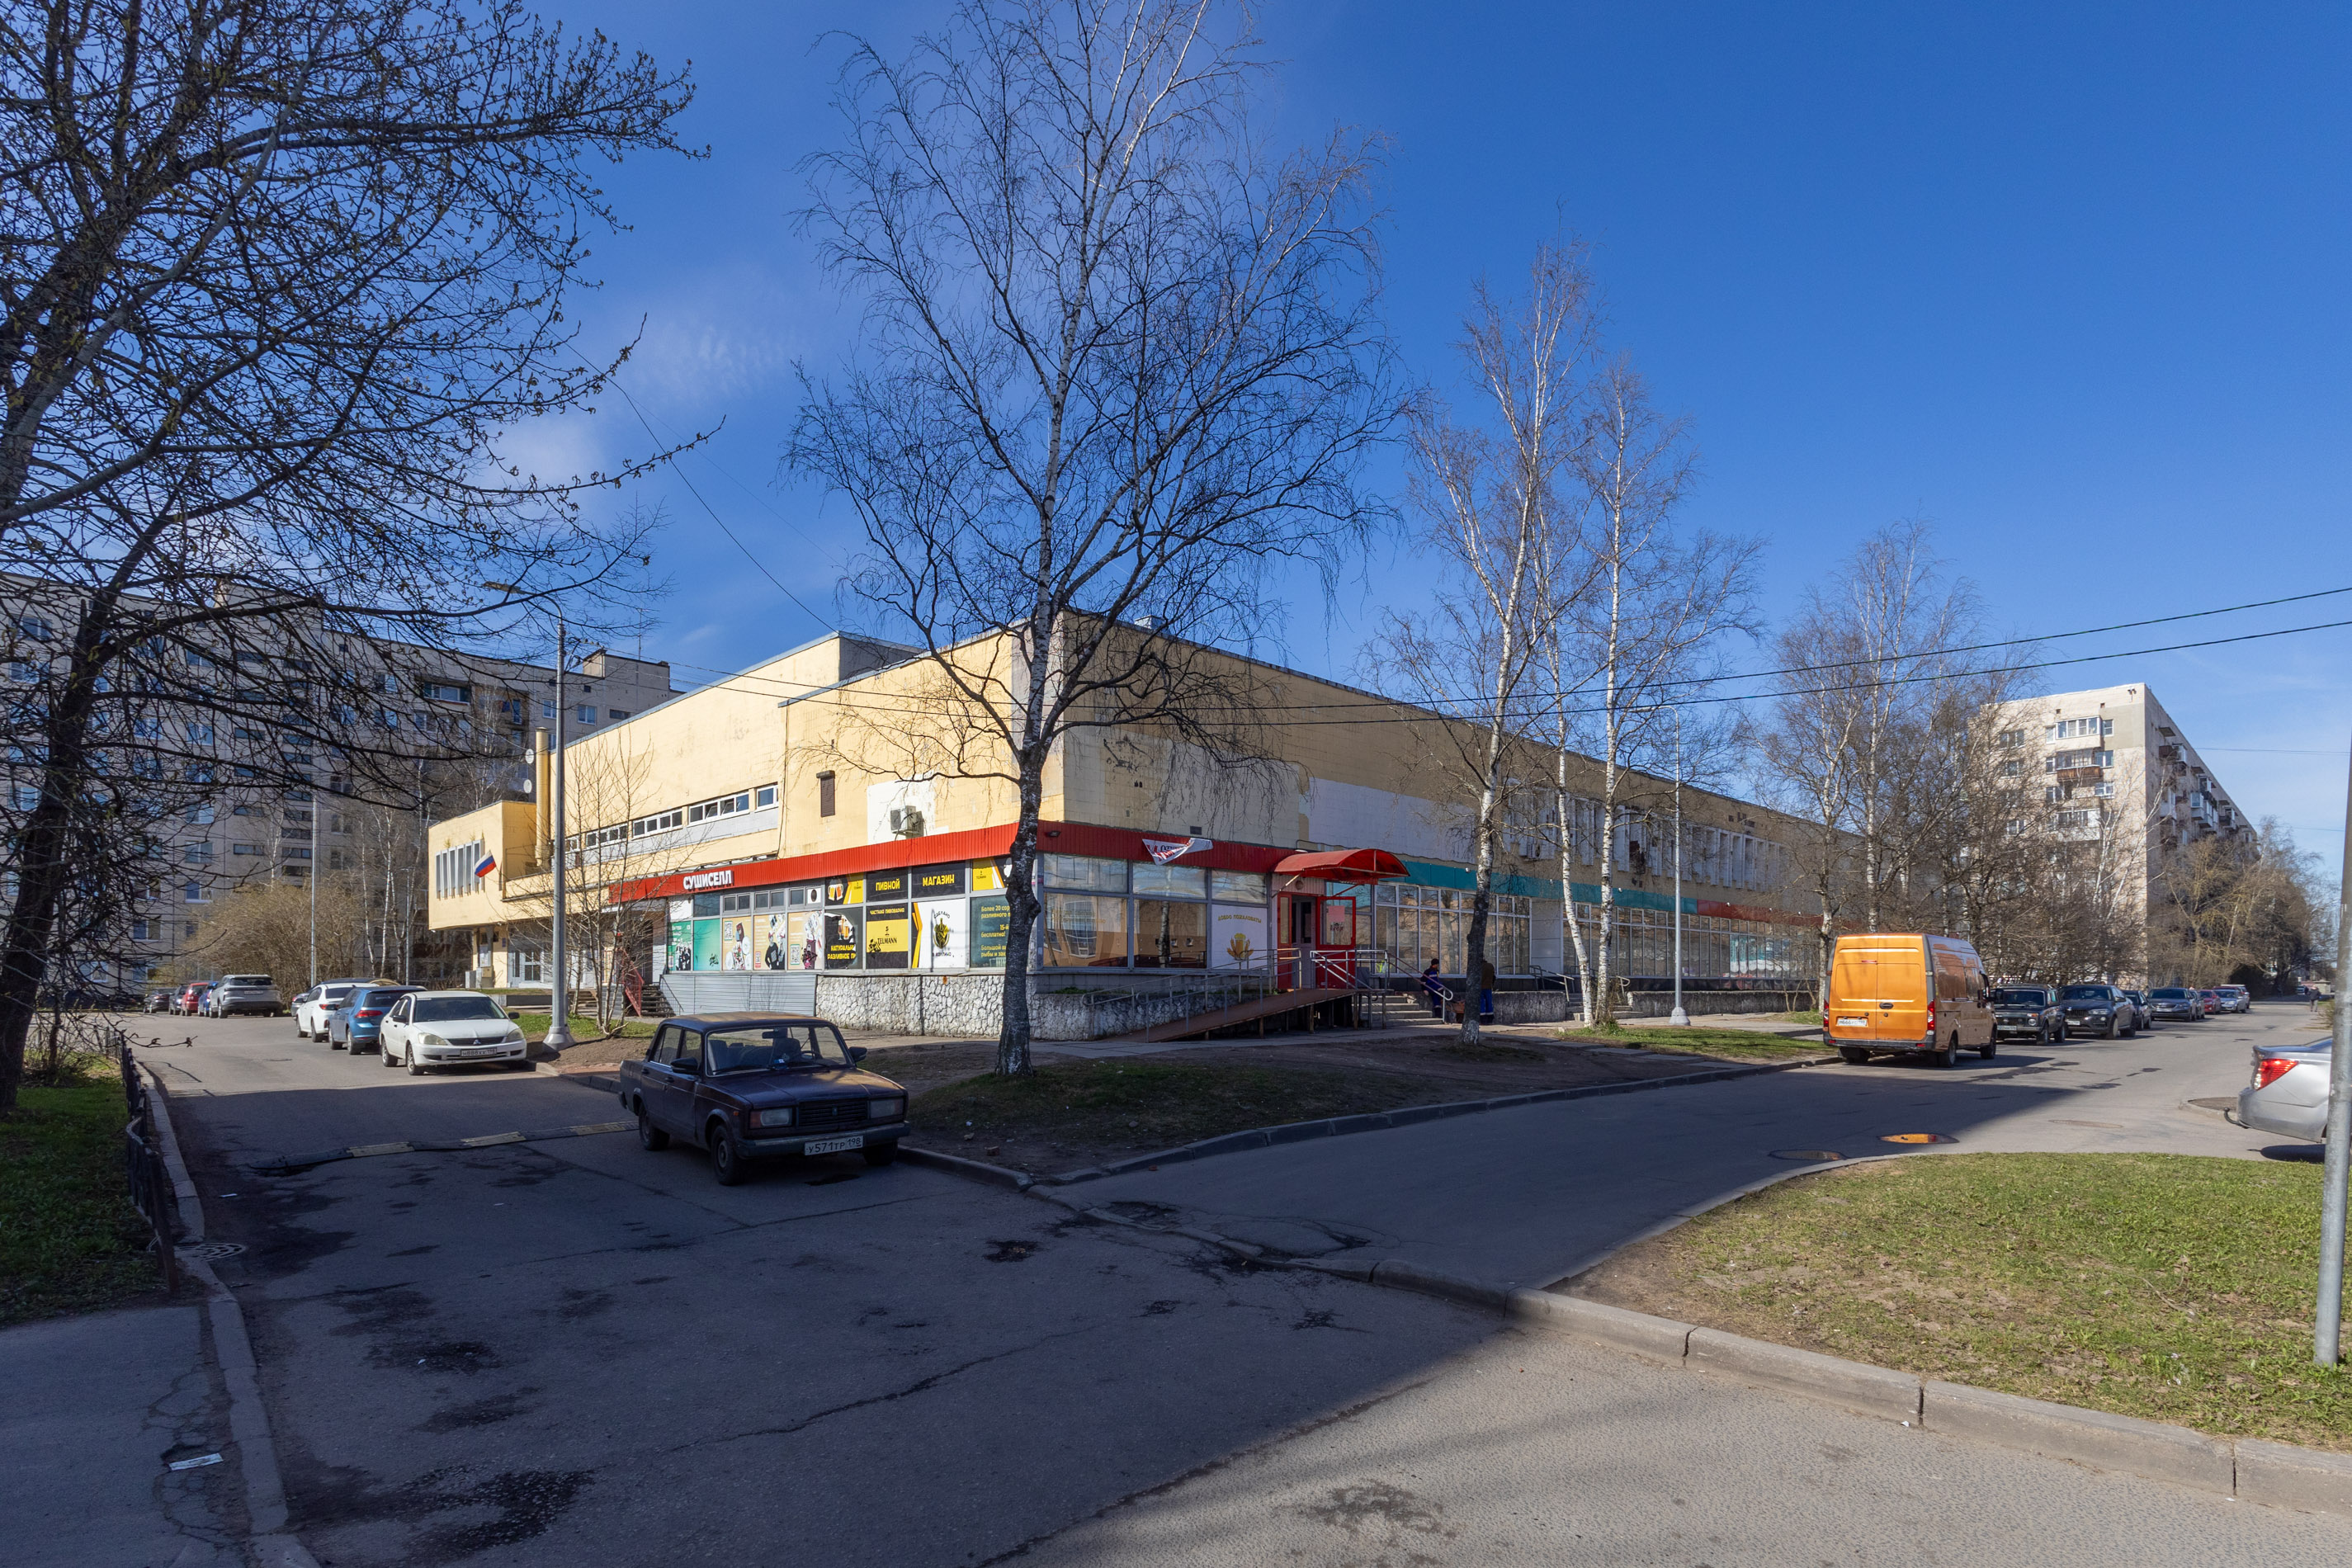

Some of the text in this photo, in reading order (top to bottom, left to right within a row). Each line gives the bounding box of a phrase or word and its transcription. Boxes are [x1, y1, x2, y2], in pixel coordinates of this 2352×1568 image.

[683, 870, 733, 890] СУШИСЕЛЛ
[876, 874, 955, 891] ПИВНОЙ МАГАЗИН
[809, 1138, 861, 1153] У571ТР 198
